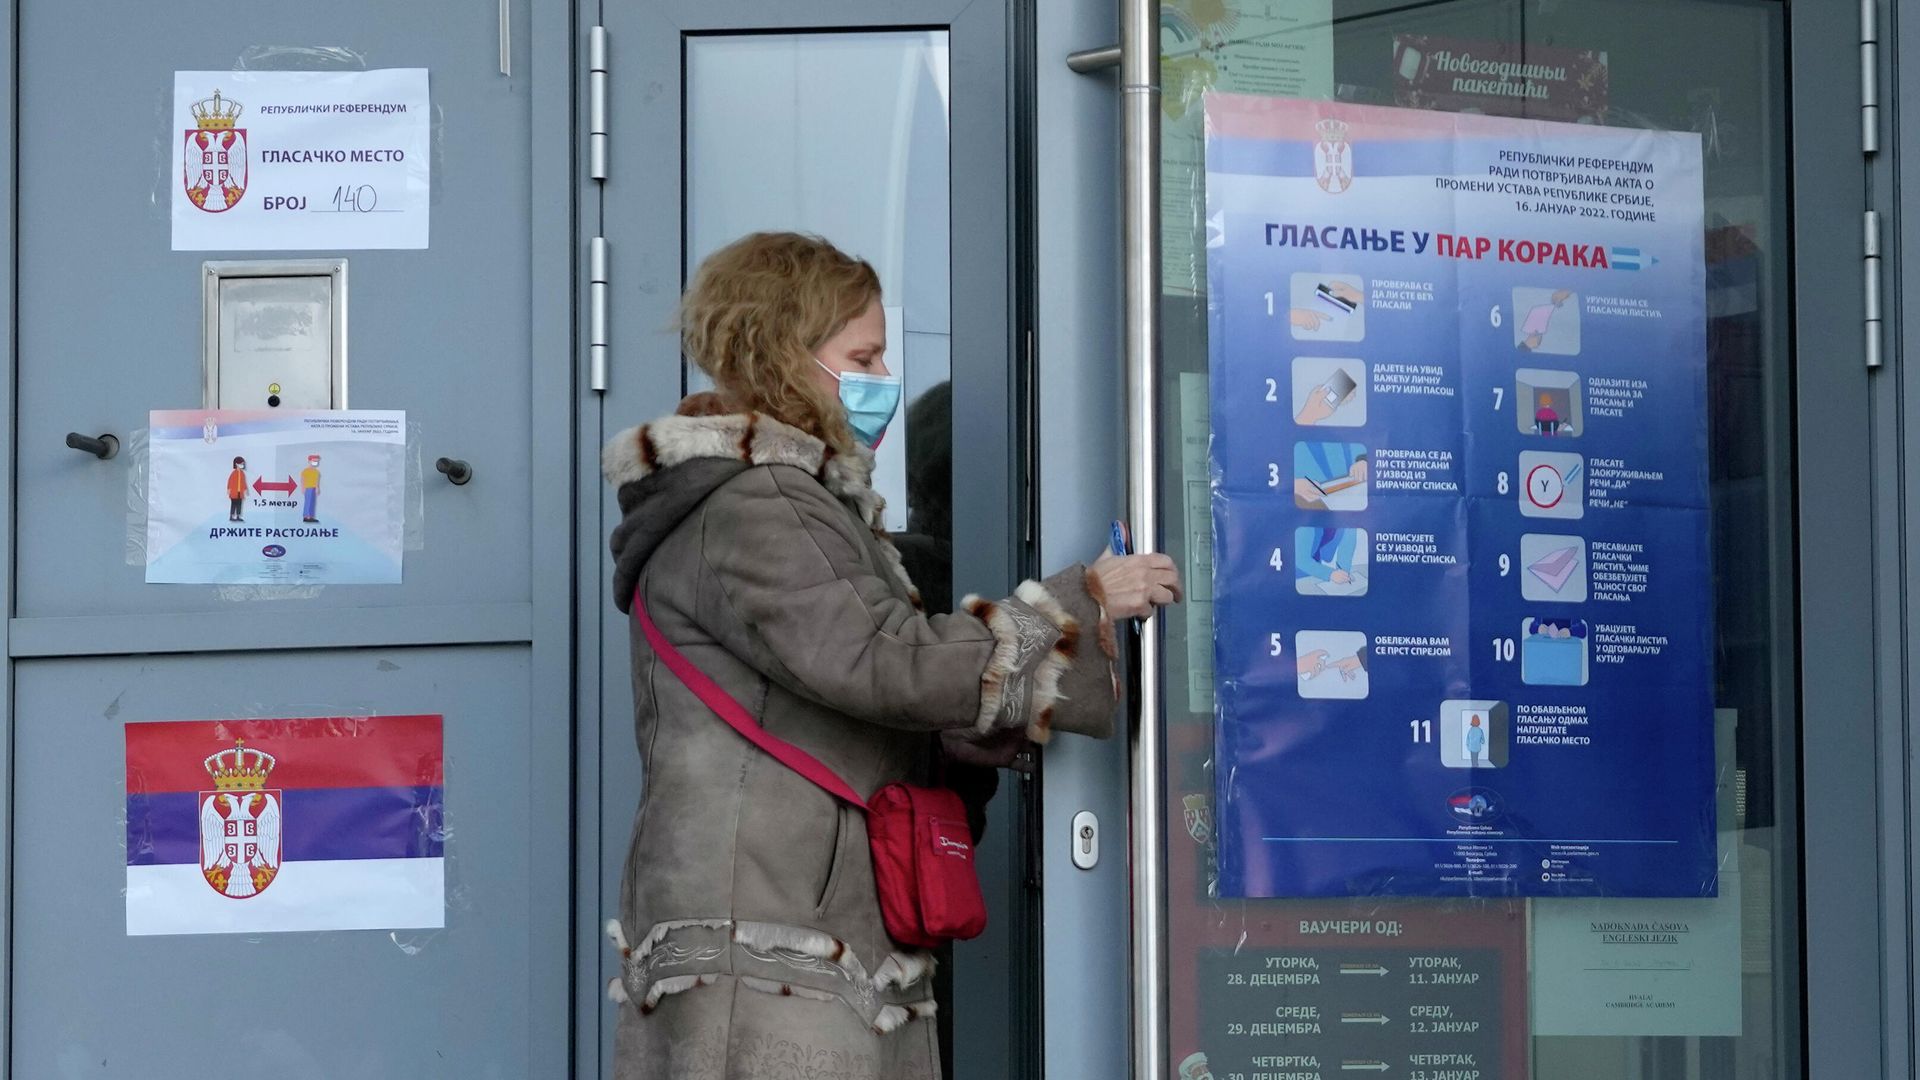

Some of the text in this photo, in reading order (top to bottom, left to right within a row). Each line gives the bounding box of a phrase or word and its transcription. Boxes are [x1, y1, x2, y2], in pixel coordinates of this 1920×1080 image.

[1435, 51, 1567, 81] Новогодишњи
[1452, 78, 1550, 100] пакетићи
[261, 103, 407, 114] РЕПУБЛИЧКИ РЕФЕРЕНДУМ
[262, 149, 404, 163] ГЛАСАЧКО МЕСТО
[1499, 150, 1654, 174] РЕПУБЛИЧКИ РЕФЕРЕНДУМ
[1489, 166, 1654, 190] РАДИ ПОТВРЂИВАЊА АКТА О
[332, 184, 377, 213] 140
[1435, 178, 1654, 208] ПРОМЕНИ УСТАВА РЕПУБЛИКЕ СРБИЈЕ,
[264, 196, 306, 210] БРОЈ
[1515, 201, 1656, 223] 16. ЈАНУАР 2022. ГОДИНЕ
[1265, 223, 1609, 269] ГЛАСАЊЕ У ПАР КОРАКА
[1372, 279, 1434, 291] ПРОВЕРАВА СЕ
[1372, 291, 1434, 302] ДА ЛИ СТЕ ВЕЋ
[1264, 292, 1274, 316] 1
[1372, 300, 1412, 310] ГЛАСАЛИ
[1619, 298, 1637, 307] ВАМ
[1638, 299, 1648, 307] СЕ
[1490, 304, 1501, 328] 6
[1587, 306, 1628, 317] ГЛАСАЧКИ
[1373, 363, 1443, 376] ДАЈЕТЕ НА УВИД
[1374, 374, 1440, 385] ВАЖЕЋУ ЛИЧНУ
[1589, 378, 1648, 388] ОДЛАЗИТЕ ИЗА
[1266, 378, 1277, 402] 2
[1374, 384, 1454, 396] КАРТУ ИЛИ ПАСОШ
[1589, 387, 1643, 398] ПАРАВАНА ЗА
[1493, 388, 1503, 410] 7
[1590, 397, 1626, 408] ГЛАСАЊЕ
[1590, 407, 1623, 417] ГЛАСАТЕ
[1376, 450, 1453, 460] ПРОВЕРАВА СЕ ДА
[1376, 460, 1450, 470] ЛИ СТЕ УПИСАНИ
[1590, 458, 1624, 467] ГЛАСАТЕ
[1268, 463, 1279, 487] 3
[1376, 471, 1426, 480] У ИЗВОД ИЗ
[1590, 469, 1663, 480] ЗАОКРУЖИВАЊЕМ
[1376, 480, 1458, 491] БИРАЧКОГ СПИСКА
[1497, 471, 1509, 495] 8
[1589, 489, 1607, 497] ИЛИ
[254, 499, 298, 508] 1,5 метар
[209, 528, 339, 539] ДРЖИТЕ РАСТОЈАЊЕ
[1376, 533, 1434, 543] ПОТПИСУЈЕТЕ
[1376, 544, 1437, 554] СЕ У ИЗВОД ИЗ
[1592, 542, 1643, 552] ПРЕСАВИЈАТЕ
[1270, 548, 1283, 571] 4
[1376, 554, 1456, 564] БИРАЧКОГ СПИСКА
[1593, 552, 1632, 562] ГЛАСАЧКИ
[1498, 554, 1510, 576] 9
[1628, 564, 1649, 573] ЧИМЕ
[1593, 572, 1647, 583] ОБЕЗБЕЂУЈЕТЕ
[1593, 582, 1647, 592] ТАЈНОСТ СВОГ
[1594, 592, 1631, 602] ГЛАСАЊА
[1595, 624, 1636, 634] УБАЦУЈЕТЕ
[1270, 633, 1282, 656] 5
[1375, 636, 1449, 646] ОБЕЛЕЖАВА ВАМ
[1596, 634, 1668, 645] ГЛАСАЧКИ ЛИСТИЋ
[1375, 646, 1451, 657] СЕ ПРСТ СПРЕЈОМ
[1493, 638, 1515, 662] 10
[1596, 645, 1661, 655] У ОДГОВАРАЈУЋУ
[1596, 655, 1625, 664] КУТИЈУ
[1517, 705, 1586, 715] ПО ОБАВЉЕНОМ
[1517, 716, 1588, 725] ГЛАСАЊУ ОДМАХ
[1411, 719, 1431, 743] 11
[1517, 726, 1567, 735] НАПУШТАТЕ
[1517, 736, 1590, 745] ГЛАСАЧКО МЕСТО
[1299, 921, 1402, 936] ВАУЧЕРИ ОД:
[1591, 922, 1649, 931] NADOKNADA
[1265, 957, 1319, 970] УТОРКА,
[1409, 957, 1462, 970] УТОРАК,
[1227, 974, 1320, 987] 28. ДЕЦЕМБРА
[1409, 973, 1480, 985] 11. ЈАНУАР
[1276, 1006, 1320, 1020] СРЕДЕ,
[1410, 1006, 1454, 1019] СРЕДУ,
[1227, 1023, 1321, 1037] 29. ДЕЦЕМБРА
[1410, 1021, 1480, 1034] 12. ЈАНУАР
[1252, 1056, 1321, 1069] ЧЕТВРТКА,
[1409, 1055, 1476, 1067] ЧЕТВРТАК,
